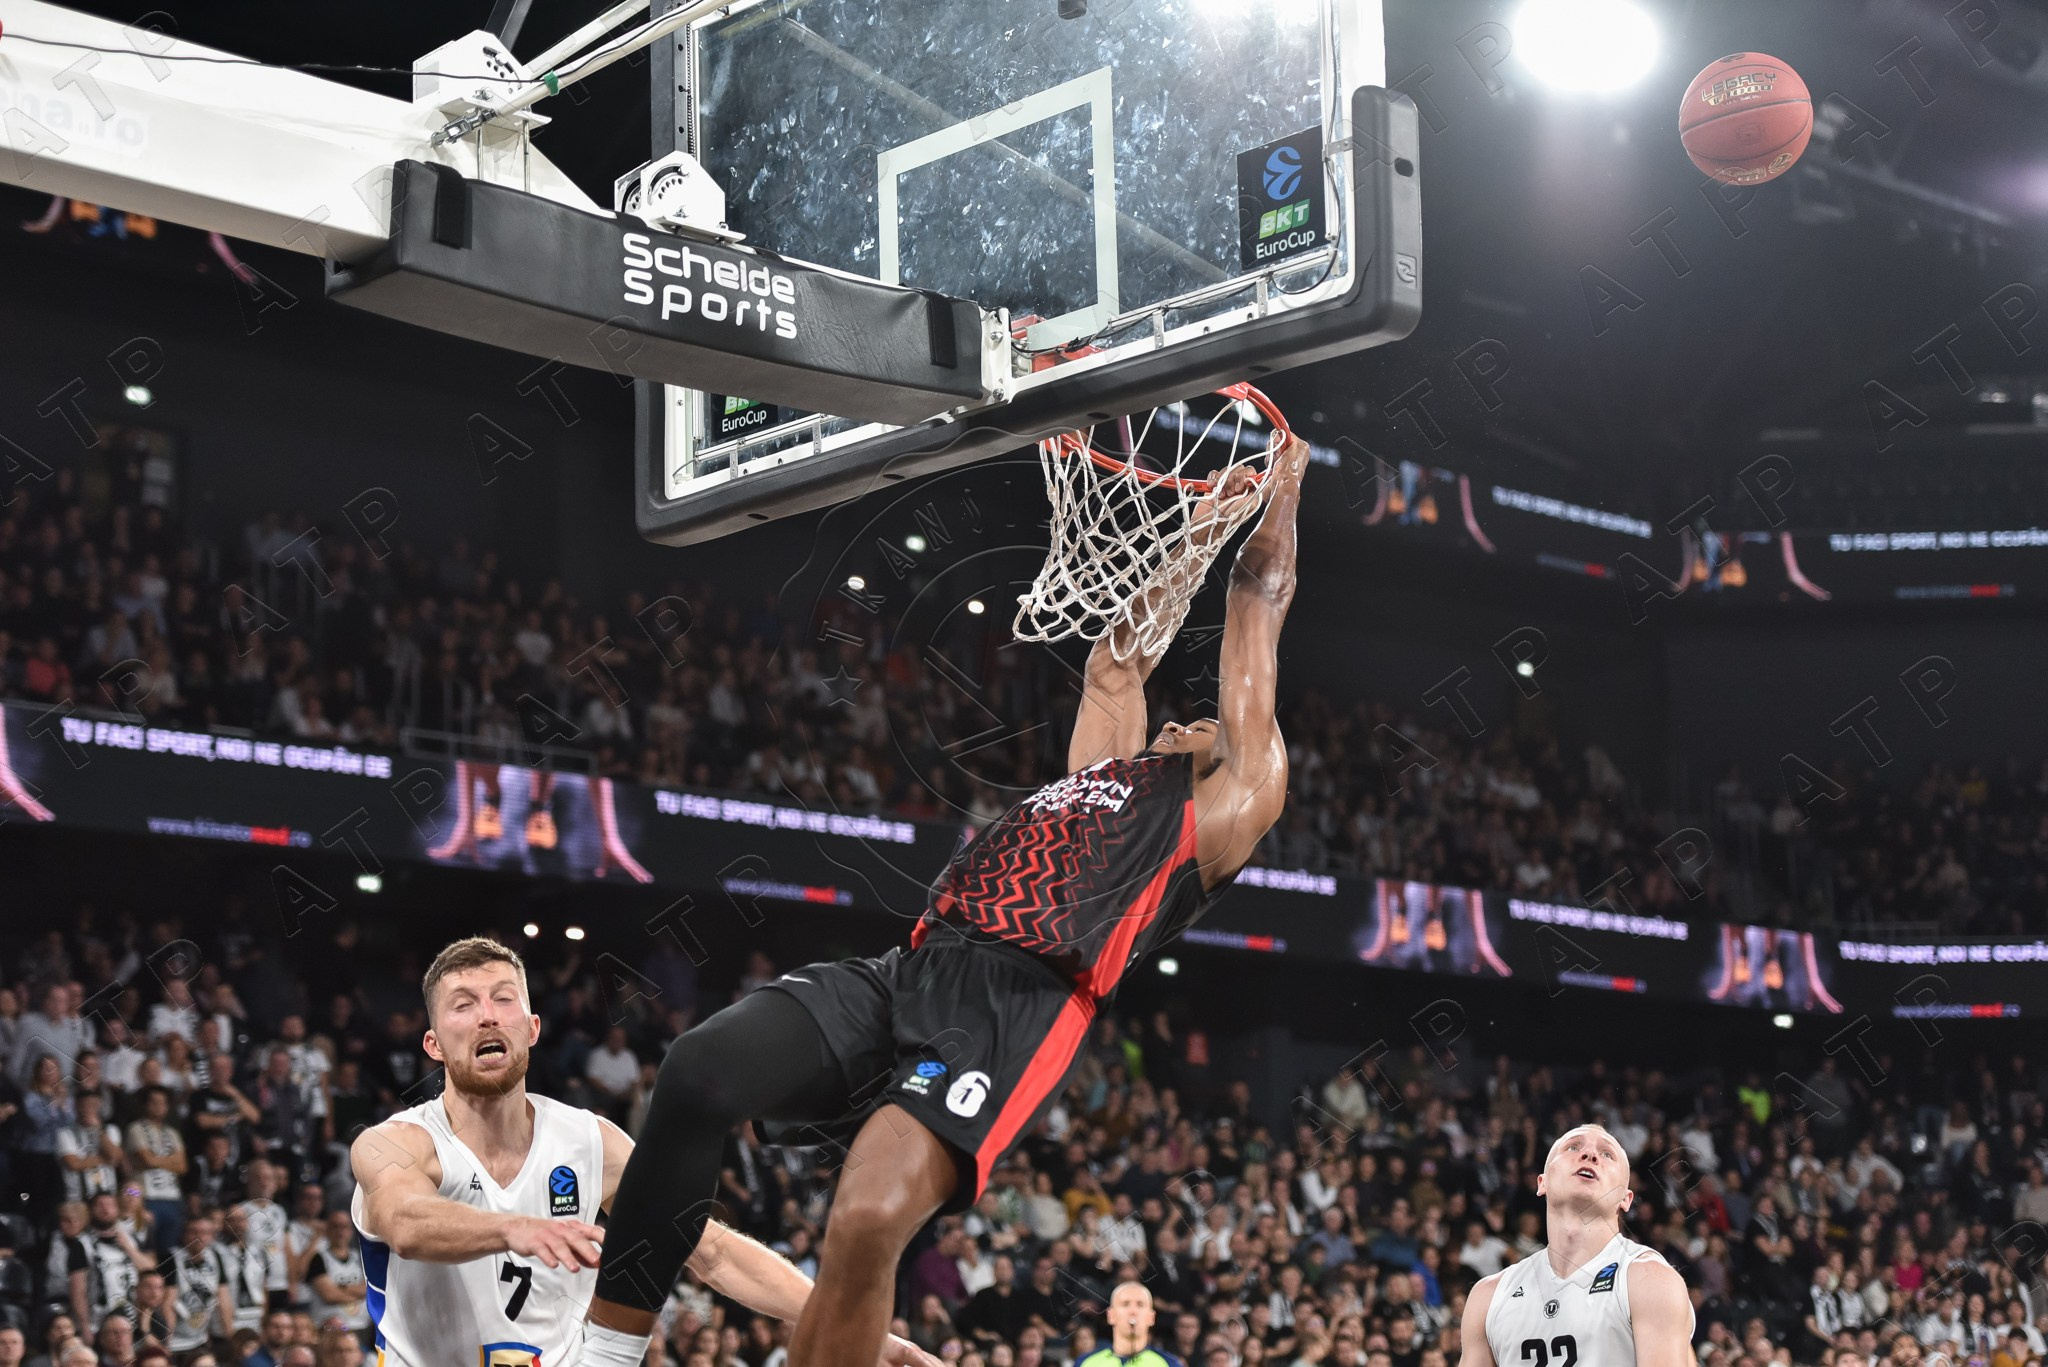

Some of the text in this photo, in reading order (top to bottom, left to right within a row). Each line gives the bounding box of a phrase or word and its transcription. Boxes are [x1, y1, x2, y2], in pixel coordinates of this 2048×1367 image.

[1702, 73, 1777, 102] LEGACY
[1260, 201, 1310, 236] BKT
[1256, 230, 1316, 259] EuroCup
[623, 232, 795, 304] Schelde
[624, 269, 797, 339] Sports
[722, 409, 767, 433] EuroCup
[946, 1070, 991, 1118] 6
[469, 1183, 483, 1191] PEA
[555, 1196, 574, 1205] BKT
[552, 1205, 578, 1213] EuroCup
[500, 1261, 532, 1322] 7
